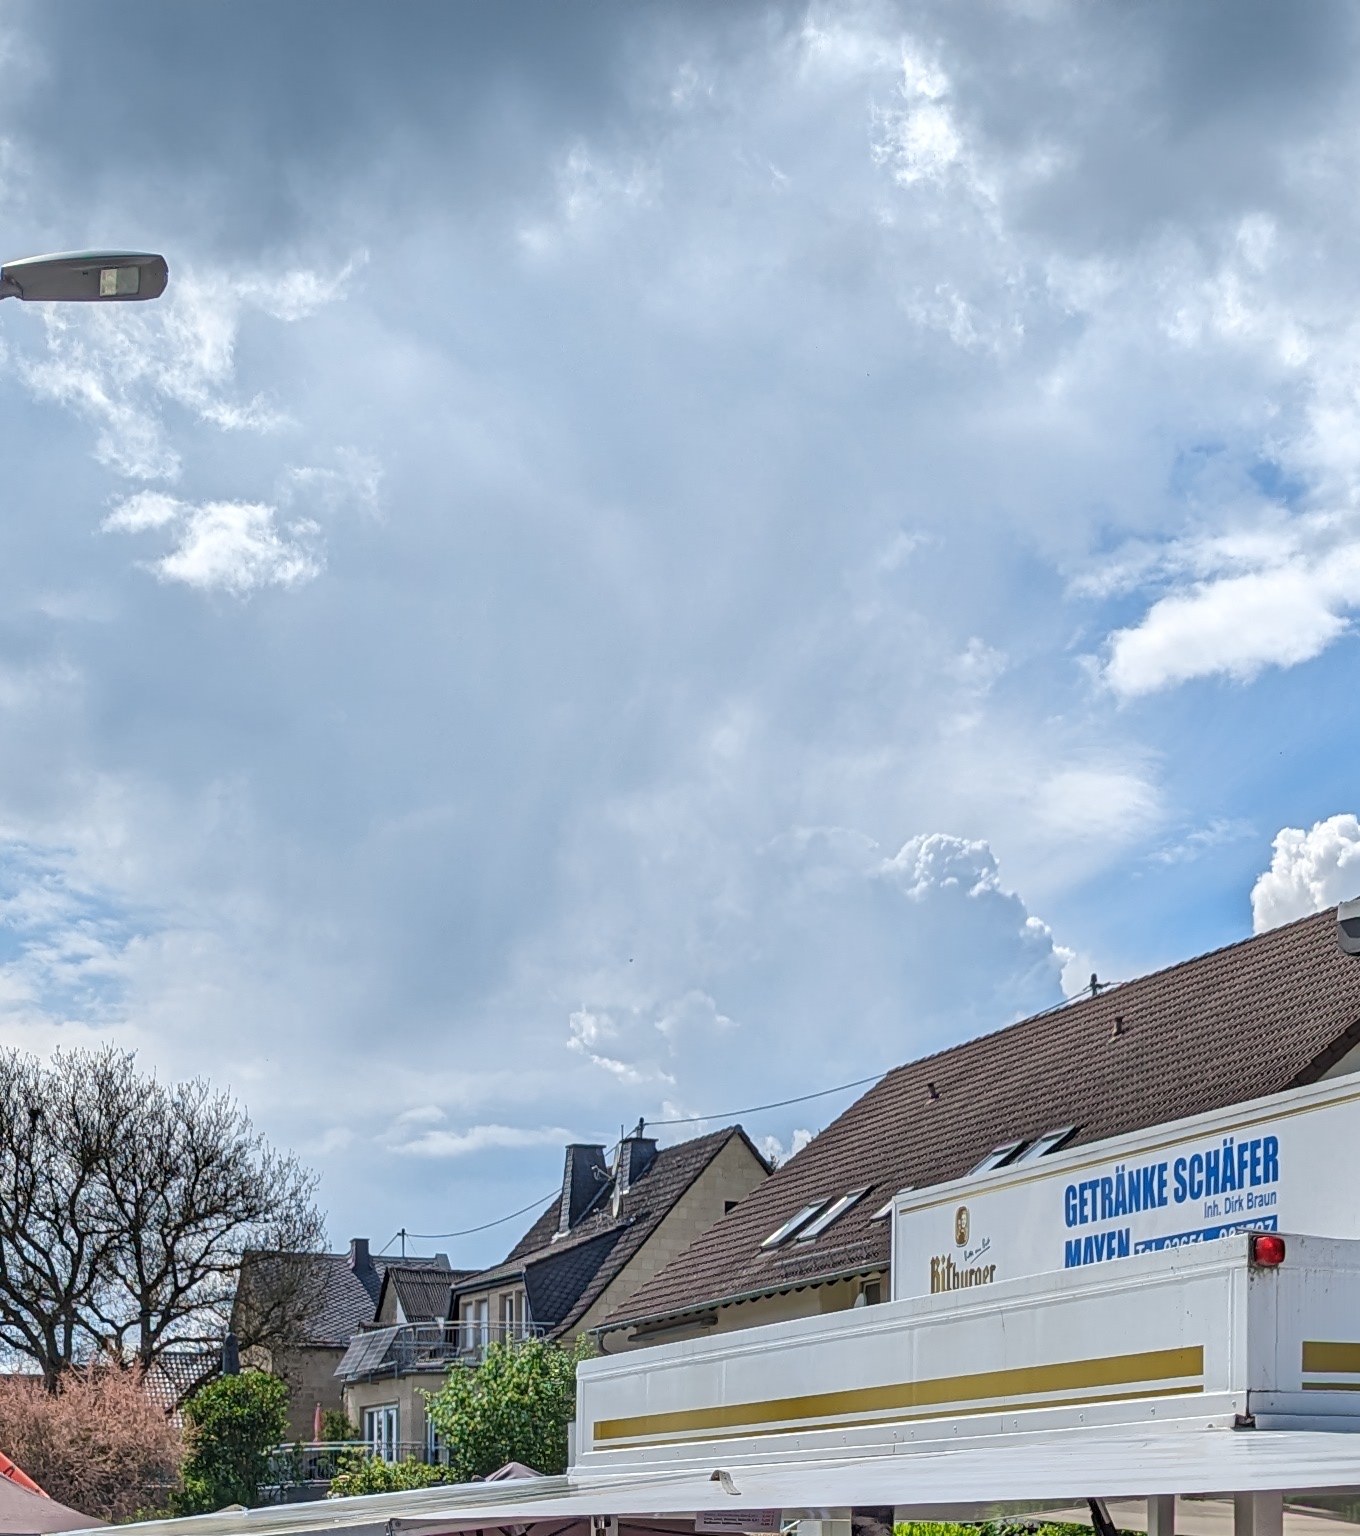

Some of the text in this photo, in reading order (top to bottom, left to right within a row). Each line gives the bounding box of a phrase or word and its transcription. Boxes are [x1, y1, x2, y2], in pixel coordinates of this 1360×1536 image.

[1065, 1136, 1278, 1228] GETRÄNKE SCHÄFER
[1204, 1191, 1277, 1219] Inh. Dirk Braun
